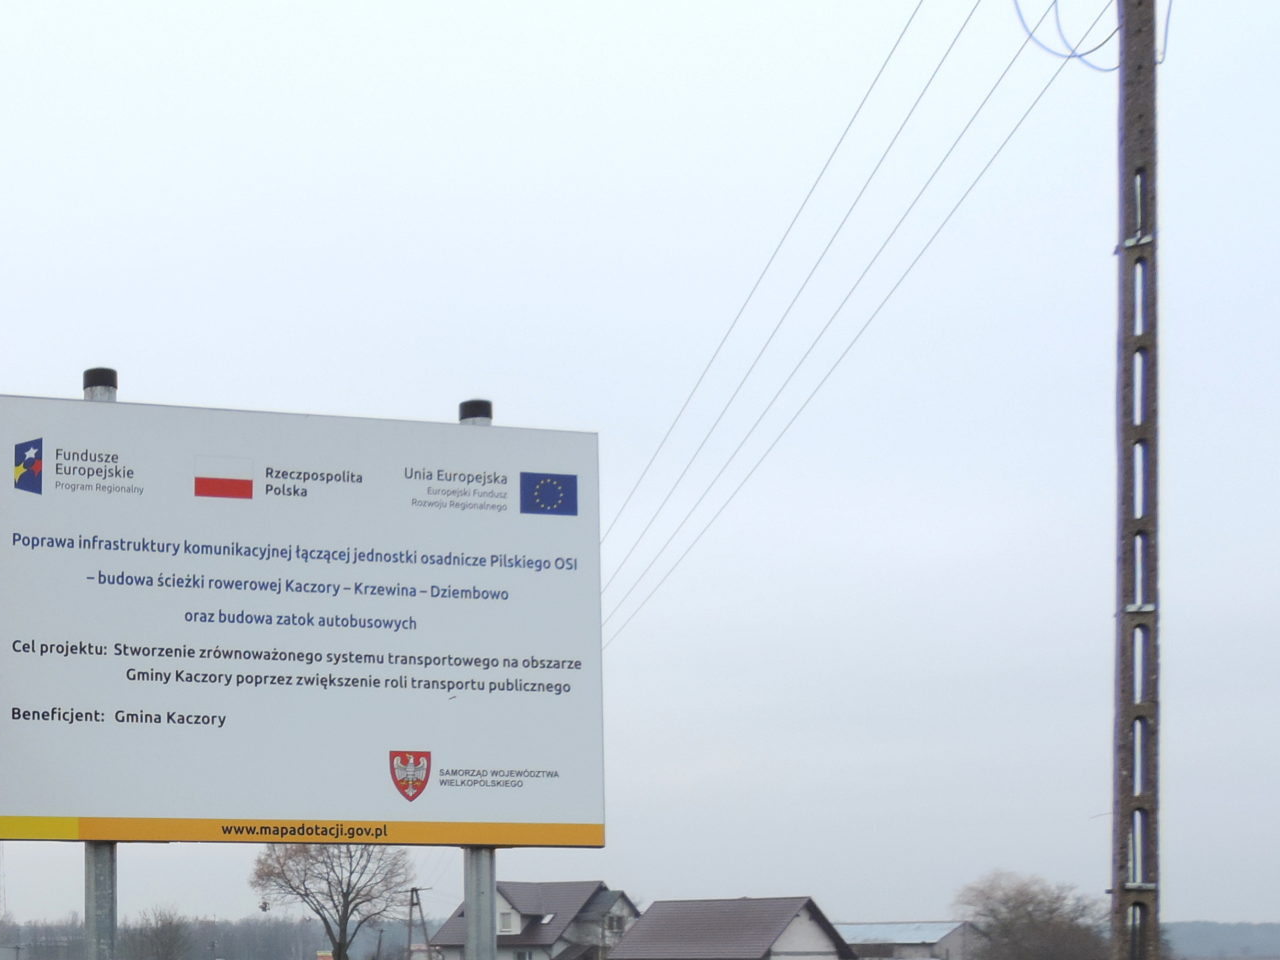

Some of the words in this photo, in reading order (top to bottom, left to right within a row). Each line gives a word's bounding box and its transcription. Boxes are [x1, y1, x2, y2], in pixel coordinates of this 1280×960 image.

[56, 449, 118, 463] Fundusze
[56, 463, 133, 480] Europejskie
[266, 467, 362, 483] Rzeczpospolita
[405, 468, 432, 480] Unia
[437, 470, 507, 486] Europejska
[56, 481, 93, 492] Program
[96, 483, 143, 495] Regionalny
[266, 484, 307, 497] Polska
[427, 487, 470, 498] Europejski
[473, 489, 507, 499] Fundusz
[412, 498, 447, 509] Rozwoju
[449, 500, 507, 512] Regionalnego
[13, 533, 74, 549] Poprawa
[79, 535, 180, 556] infrastruktury
[184, 540, 291, 561] komunikacyjnej
[296, 545, 350, 564] łączącej
[353, 548, 416, 564] jednostki
[421, 552, 486, 566] osadnicze
[491, 554, 551, 572] Pilskiego
[555, 557, 577, 570] OSI
[99, 570, 153, 586] budowa
[158, 573, 204, 588] ścieżki
[209, 578, 281, 594] rowerowej
[286, 579, 340, 596] Kaczory
[355, 583, 416, 597] Krzewina
[431, 585, 508, 600] Dziembowo
[185, 612, 214, 622] oraz
[219, 609, 272, 624] budowa
[277, 613, 314, 626] zatok
[318, 614, 416, 632] autobusowych
[12, 640, 35, 652] Cel
[40, 641, 107, 657] projektu:
[114, 643, 195, 658] Stworzenie
[199, 646, 322, 664] zrównoważonego
[327, 652, 383, 665] systemu
[388, 653, 499, 670] transportowego
[503, 659, 518, 668] na
[522, 656, 581, 669] obszarze
[127, 668, 171, 684] Gminy
[176, 670, 232, 686] Kaczory
[237, 675, 292, 687] poprzez
[296, 673, 380, 689] zwiększenie
[385, 676, 407, 688] roli
[411, 678, 484, 692] transportu
[489, 679, 570, 695] publicznego
[12, 707, 104, 724] Beneficjent:
[115, 710, 161, 723] Gmina
[167, 712, 226, 728] Kaczory
[440, 769, 488, 779] SAMORZĄD
[490, 769, 559, 778] WOJEWÓDZTWA
[440, 779, 523, 787] WIELKOPOLSKIEGO
[222, 824, 387, 839] www.mapadotacji.gov.pl
